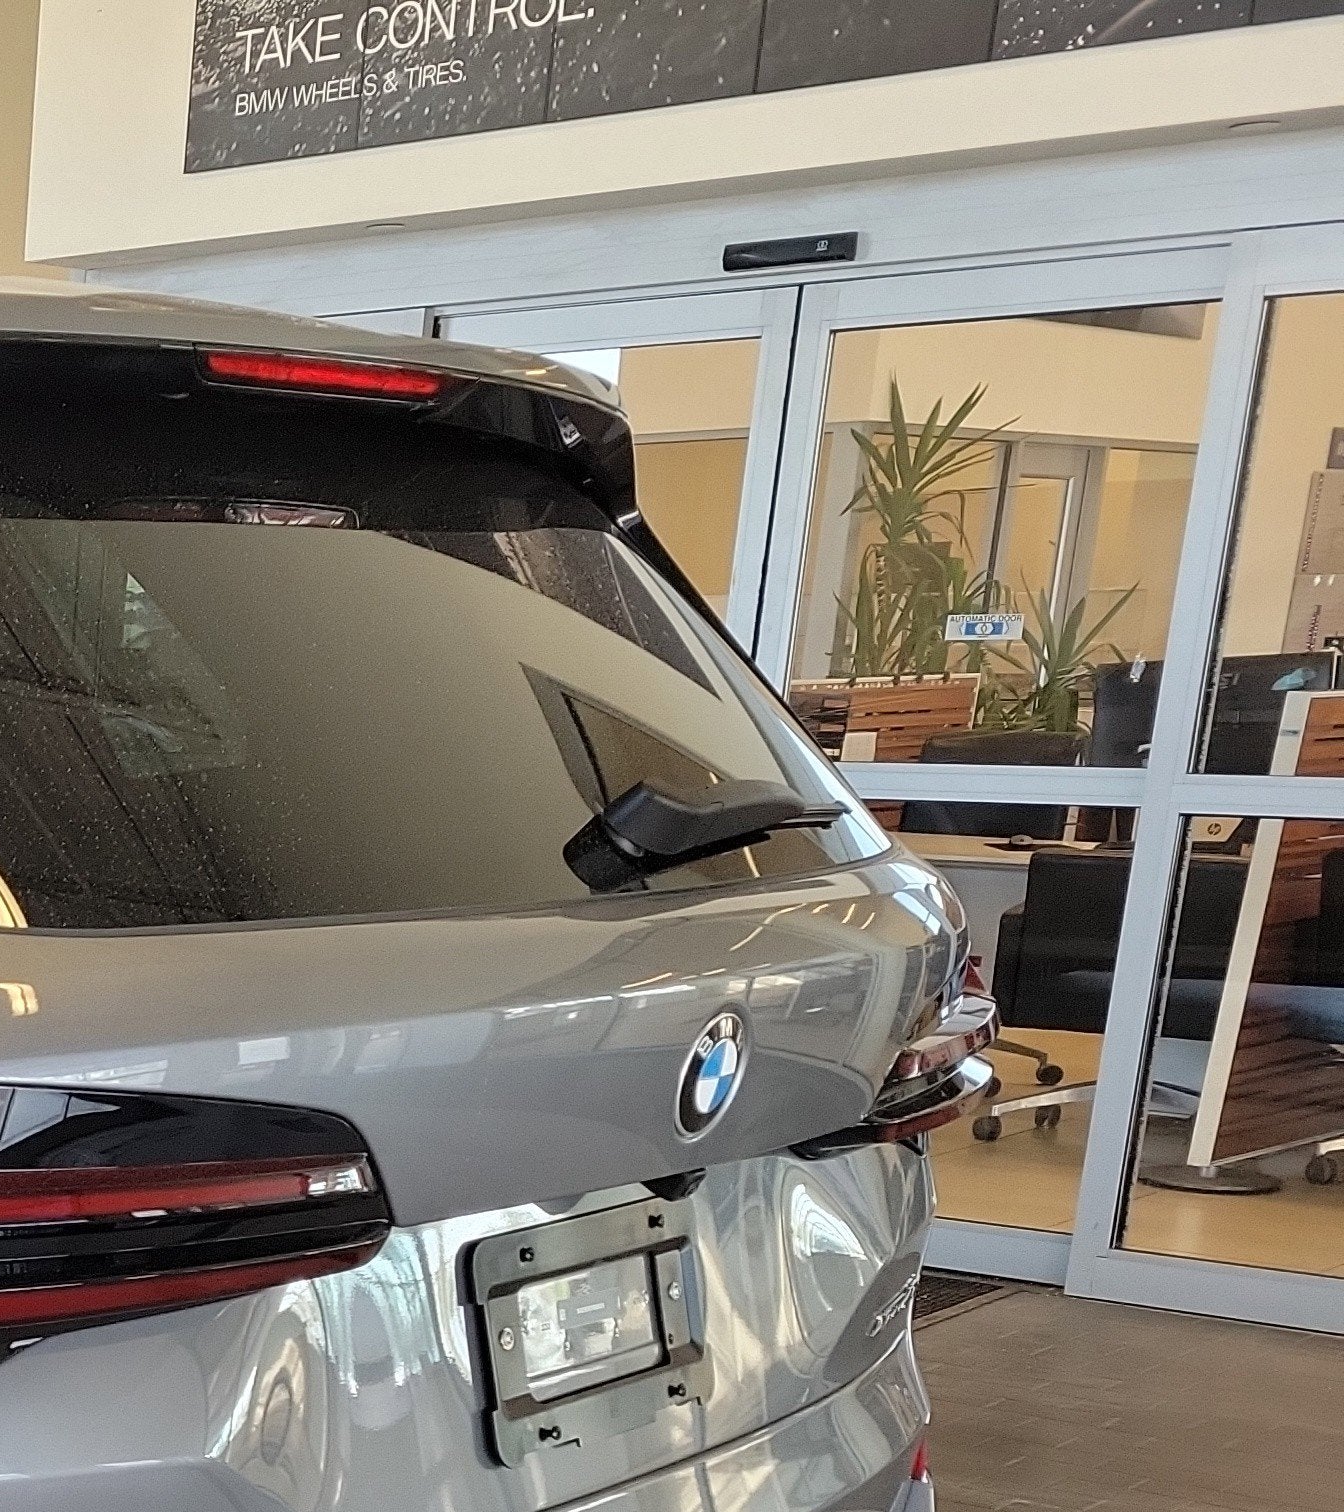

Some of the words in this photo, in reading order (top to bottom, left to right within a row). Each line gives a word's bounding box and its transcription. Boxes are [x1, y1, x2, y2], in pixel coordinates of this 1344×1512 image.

[236, 13, 343, 75] TAKE
[235, 87, 288, 116] BMW
[293, 75, 378, 107] WHEELS
[383, 70, 399, 94] &
[405, 60, 467, 90] TIRES.
[950, 615, 996, 623] AUTOMATIC
[1207, 822, 1222, 836] hp
